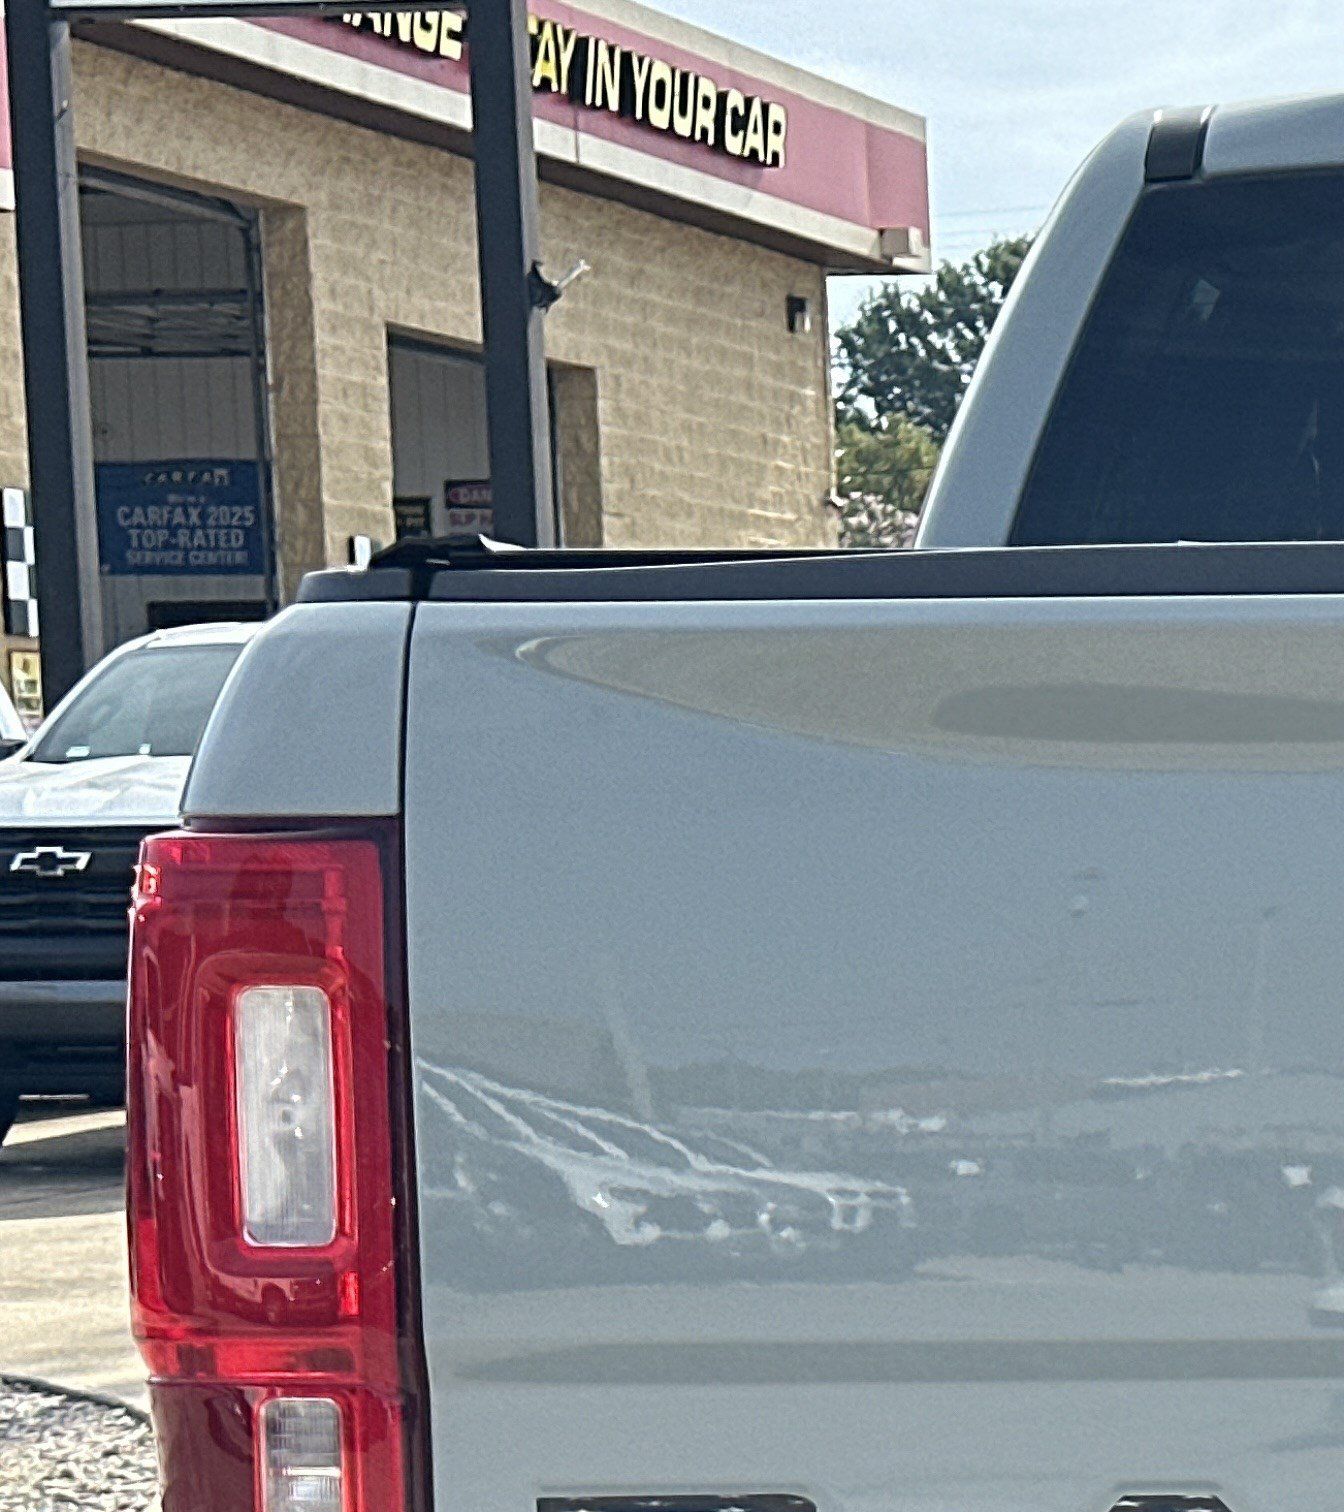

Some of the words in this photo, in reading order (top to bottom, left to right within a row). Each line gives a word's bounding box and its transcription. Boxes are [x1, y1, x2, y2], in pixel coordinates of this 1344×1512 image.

[585, 36, 621, 112] IN
[632, 50, 718, 146] YOUR
[723, 87, 788, 169] CAR
[117, 506, 202, 527] CARFAX
[206, 506, 256, 527] 2025
[128, 528, 245, 549] TOP-RATED
